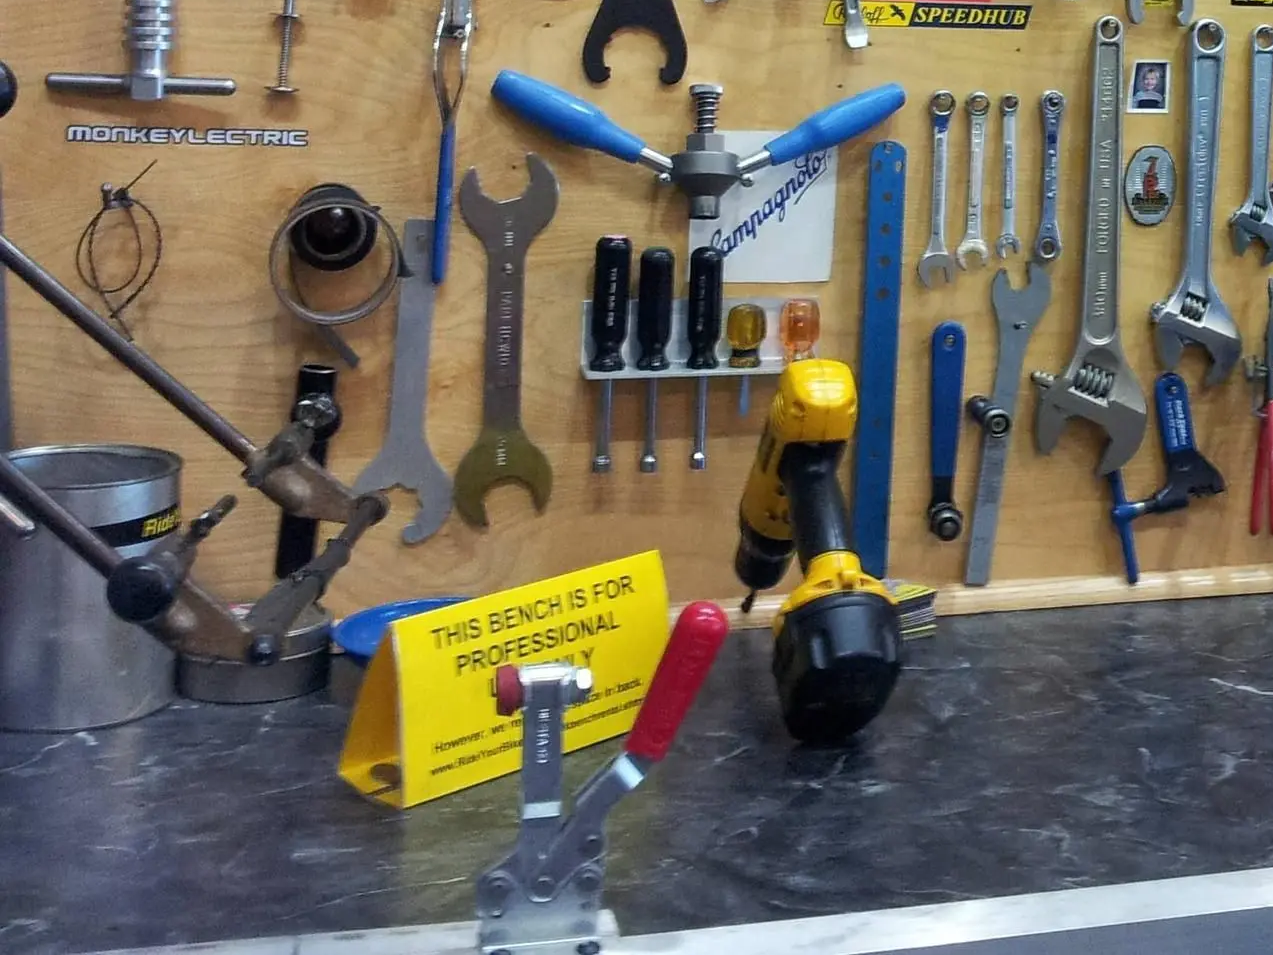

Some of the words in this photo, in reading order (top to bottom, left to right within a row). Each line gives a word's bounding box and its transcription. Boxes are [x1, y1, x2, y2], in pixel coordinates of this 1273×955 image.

[915, 9, 1025, 26] SPEEDHUB
[67, 125, 308, 146] MONKEYLECTRIC
[431, 617, 484, 649] THIS
[488, 596, 564, 634] BENCH
[567, 588, 588, 610] IS
[593, 575, 636, 604] FOR
[454, 610, 622, 676] PROFESSIONAL
